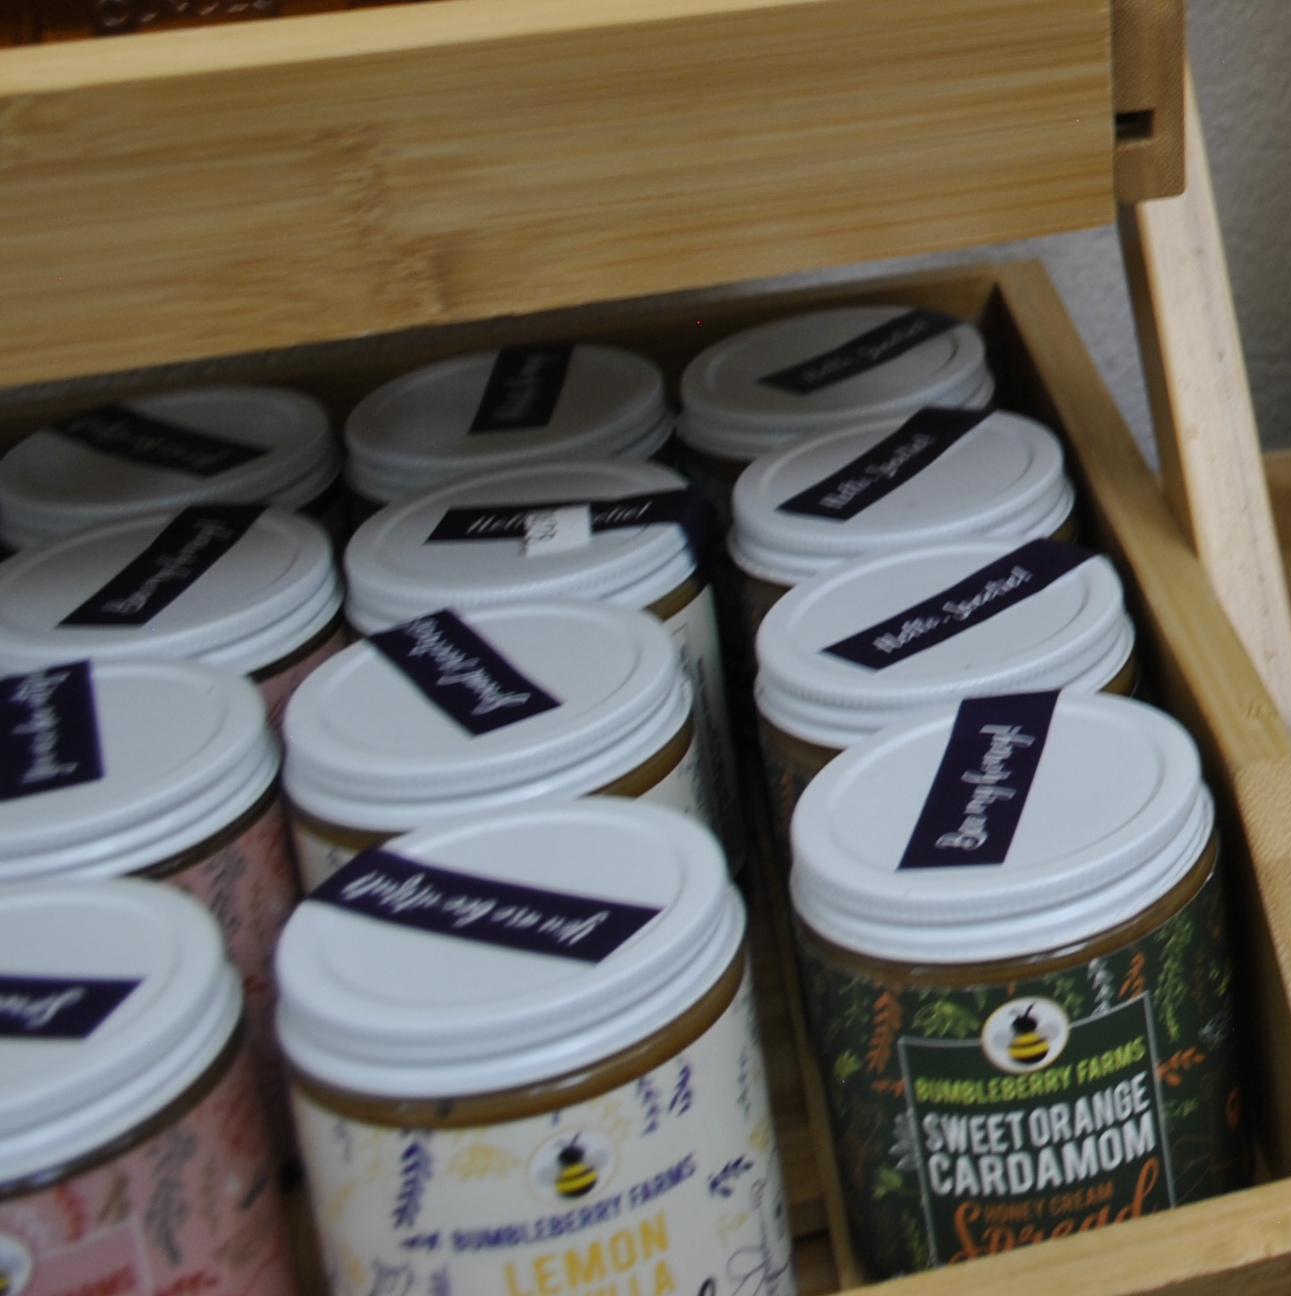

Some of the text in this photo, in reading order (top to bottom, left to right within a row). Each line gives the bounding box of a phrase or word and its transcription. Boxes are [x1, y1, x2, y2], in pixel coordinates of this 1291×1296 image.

[914, 1035, 1147, 1104] BUMBLEBERRY FARMS
[922, 1071, 1151, 1154] SWEET ORANGE
[927, 1109, 1157, 1197] CARDAMOM
[451, 1151, 698, 1253] BUMBLEBERRY FARMS
[504, 1210, 670, 1296] LEMON
